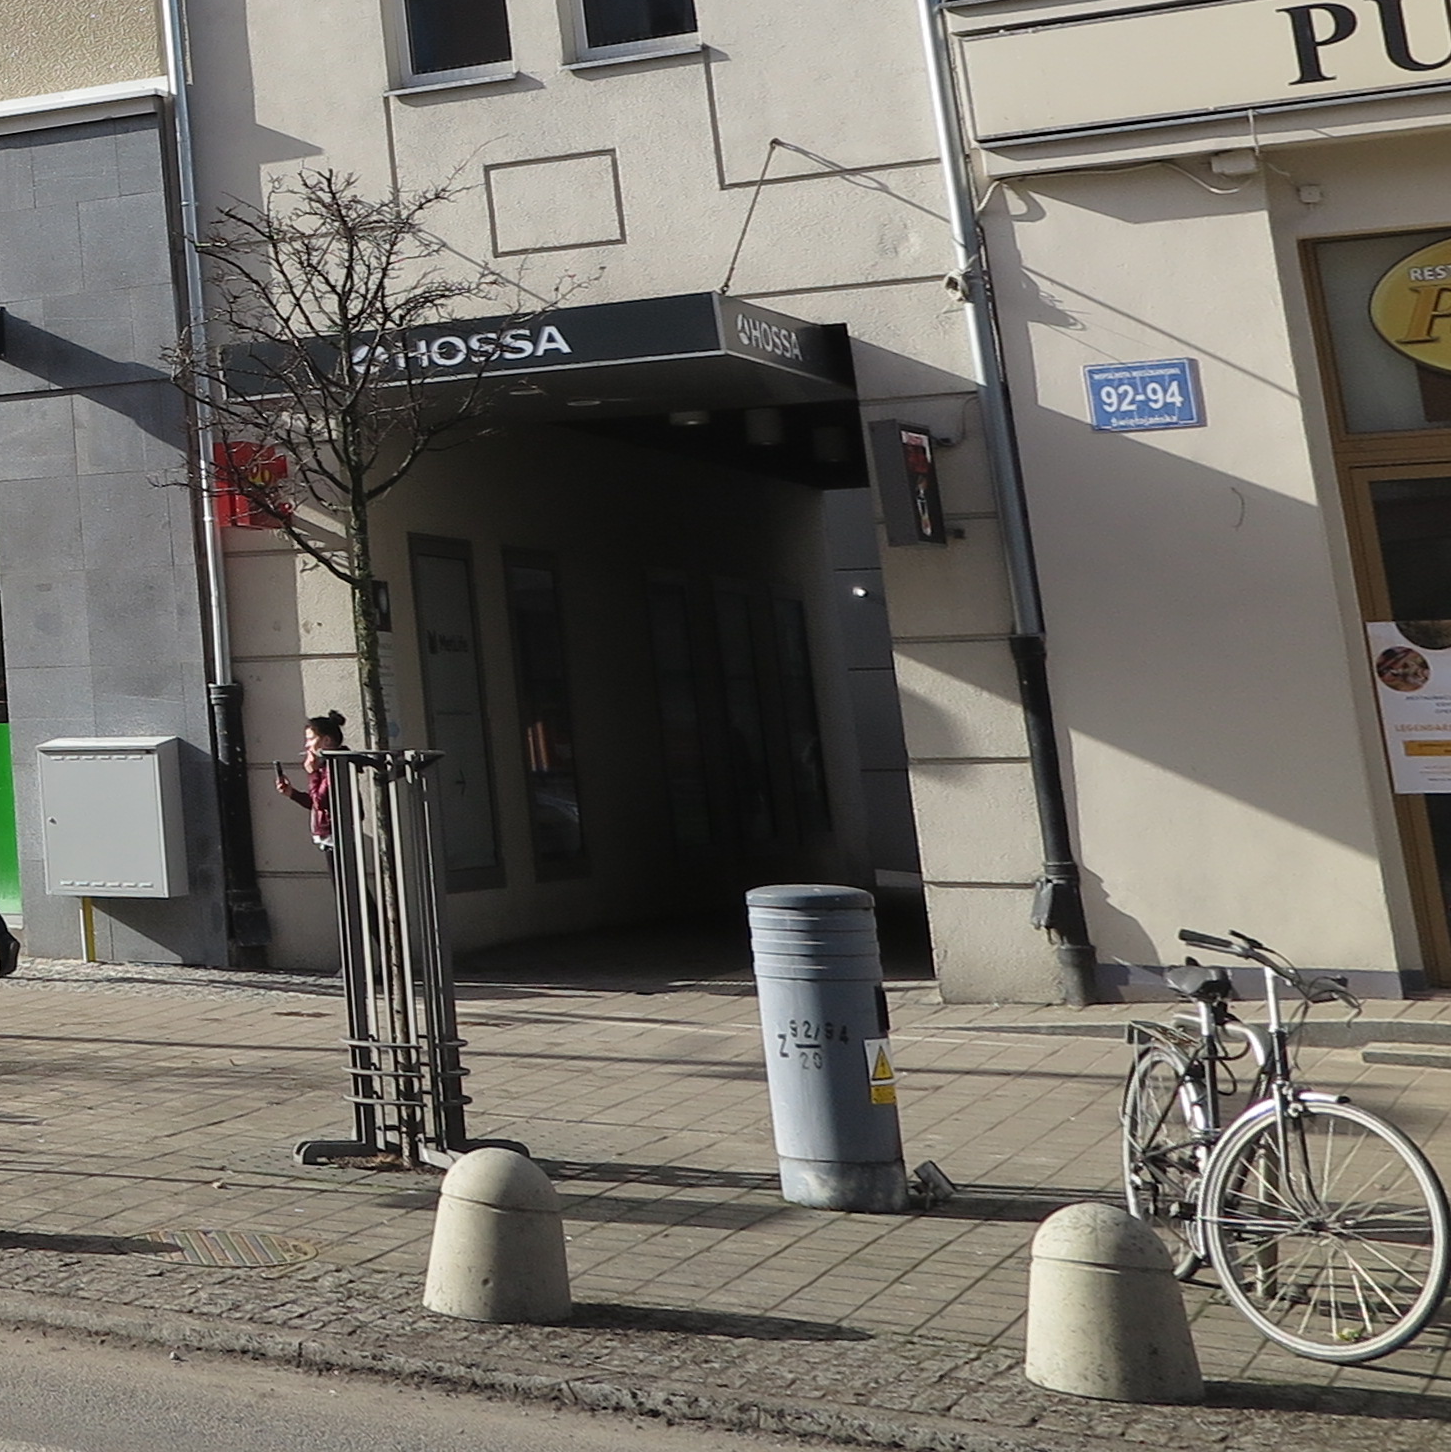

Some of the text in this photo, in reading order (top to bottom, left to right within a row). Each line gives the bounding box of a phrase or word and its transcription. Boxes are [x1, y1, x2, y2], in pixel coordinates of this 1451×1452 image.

[396, 324, 573, 371] HOSSA
[748, 318, 804, 362] HOSSA
[1100, 380, 1185, 413] 92-94
